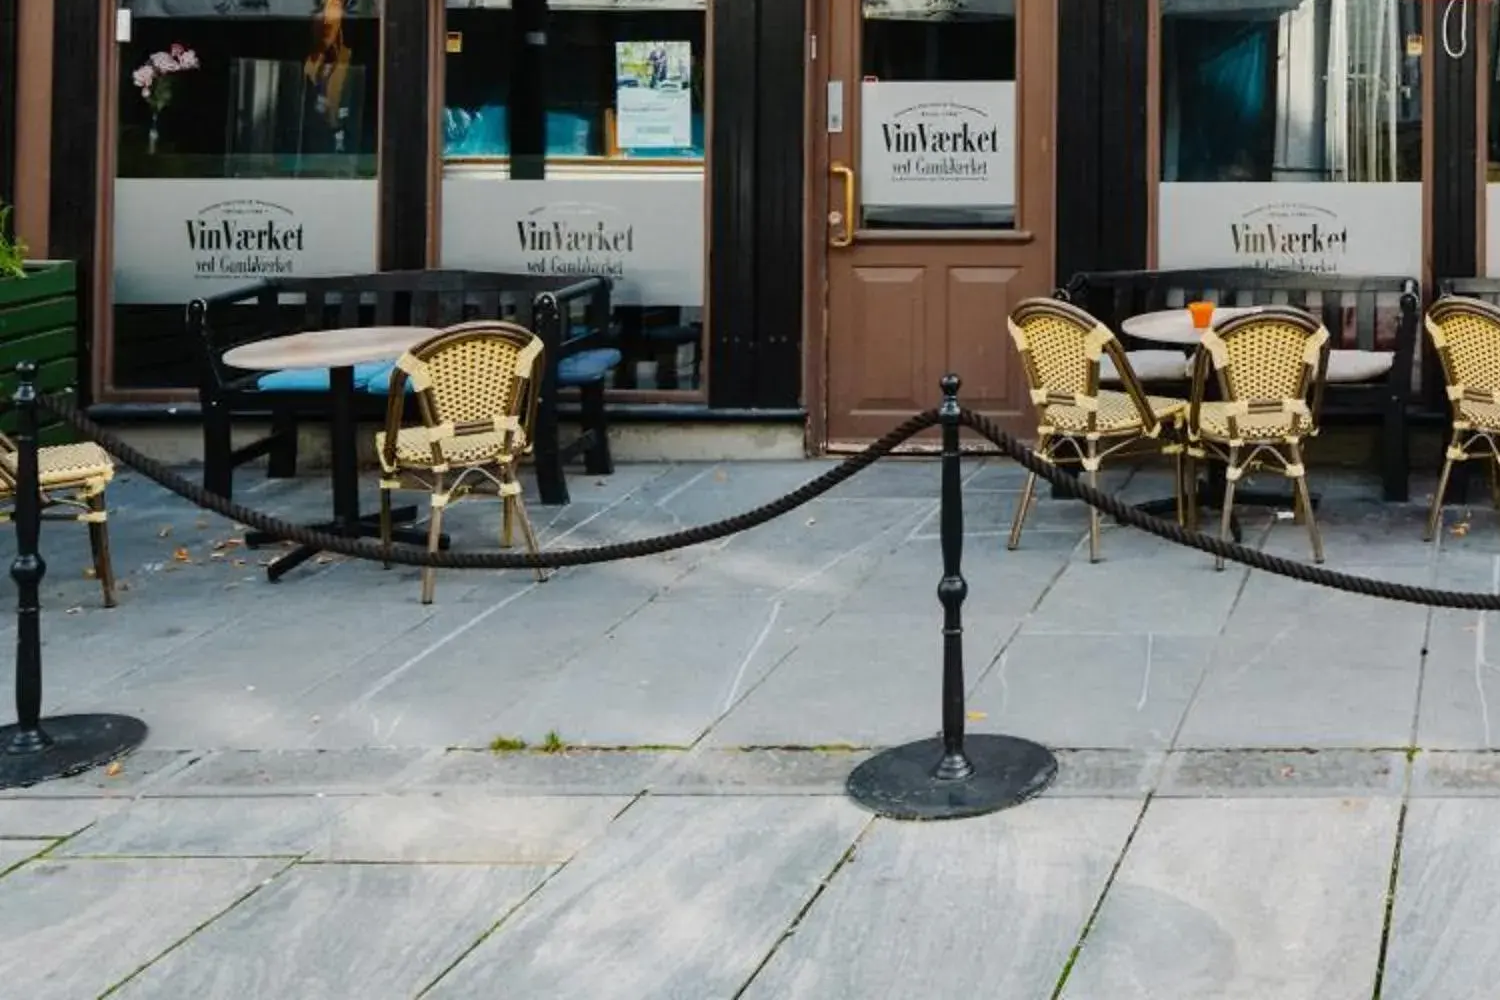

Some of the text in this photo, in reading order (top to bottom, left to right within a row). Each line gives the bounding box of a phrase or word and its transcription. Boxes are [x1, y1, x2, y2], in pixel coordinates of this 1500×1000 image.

[882, 122, 1000, 152] VinVærket
[186, 219, 304, 251] VinVærket
[517, 220, 634, 252] VinVærket
[1231, 223, 1347, 254] VinVærket
